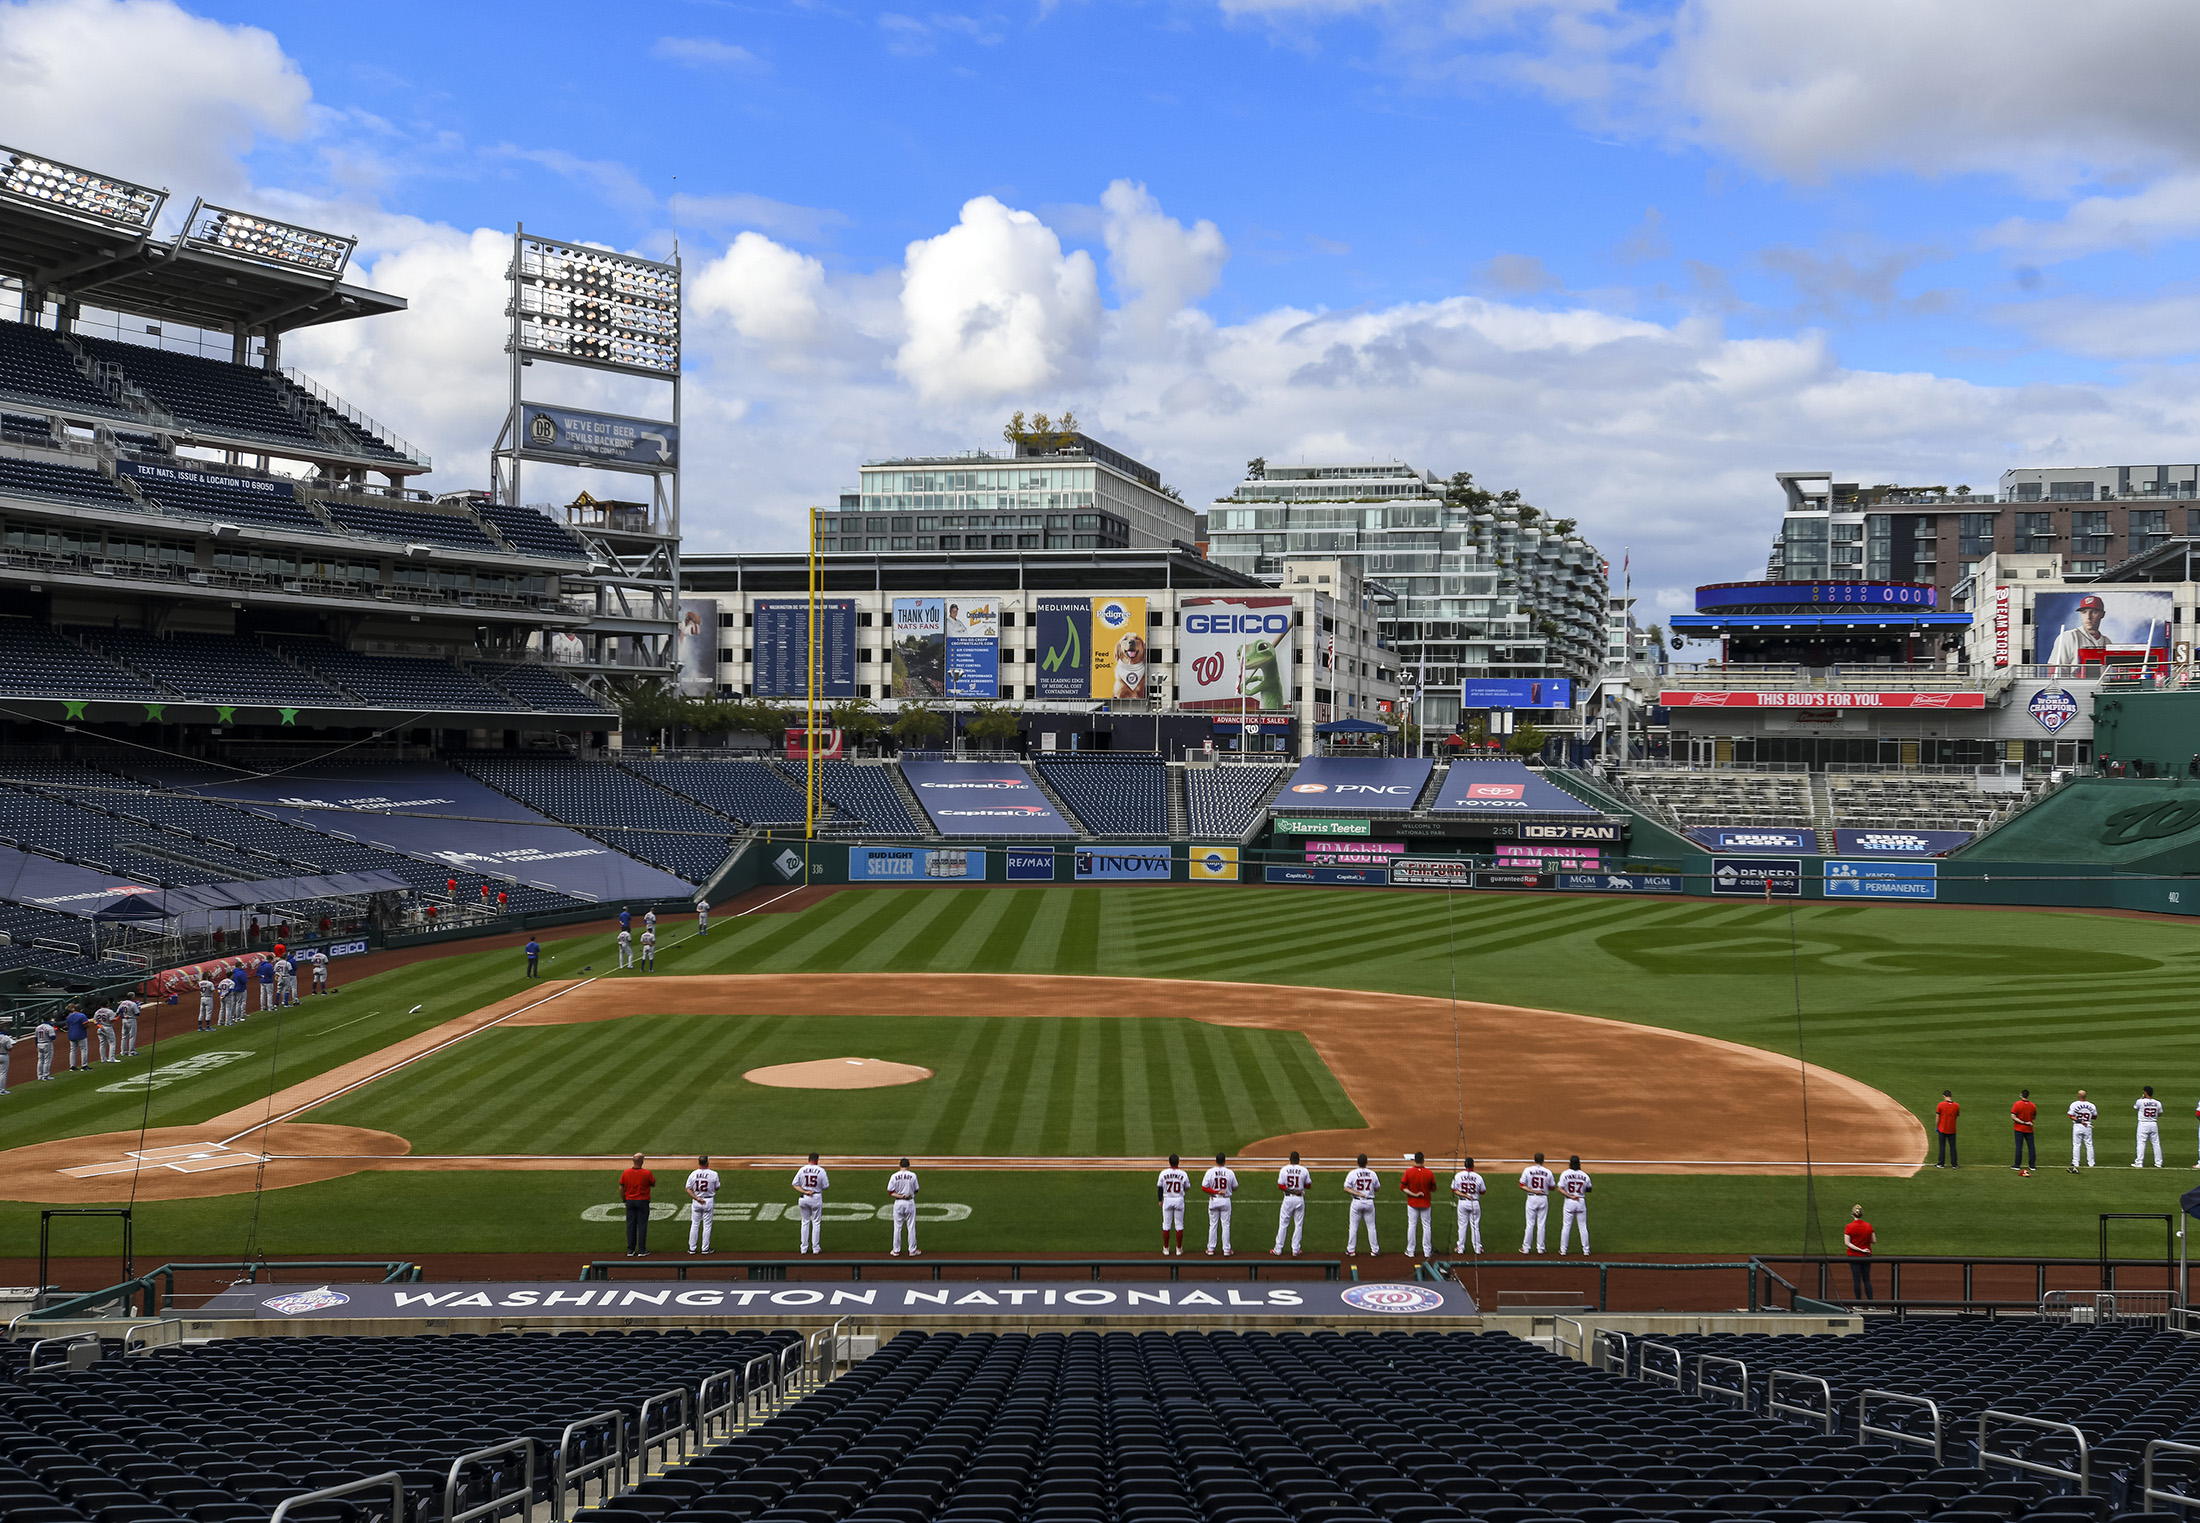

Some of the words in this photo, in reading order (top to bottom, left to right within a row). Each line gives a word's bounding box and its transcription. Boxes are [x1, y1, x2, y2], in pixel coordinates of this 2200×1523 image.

[564, 418, 592, 432] WE'VE
[593, 424, 610, 434] GOT
[613, 425, 637, 438] BEER.
[565, 431, 593, 444] DEVILS
[594, 435, 634, 450] BACKBONE
[573, 443, 599, 453] BREWING
[600, 446, 626, 456] COMPANY
[137, 465, 155, 475] TEXT
[156, 468, 176, 480] NATS,
[178, 471, 198, 482] ISSUE
[206, 475, 239, 487] LOCATION
[241, 480, 250, 488] TO
[251, 481, 274, 491] 69050
[1883, 588, 1893, 601] 0
[1900, 589, 1908, 602] 0
[1914, 590, 1921, 602] 0
[1037, 604, 1090, 612] MEDLIMINAL
[897, 609, 924, 623] THANK
[925, 606, 940, 623] YOU
[1096, 610, 1131, 619] Pedigree
[1996, 603, 2008, 628] TEAM
[1186, 614, 1288, 634] GEICO
[1771, 647, 1805, 656] ULTRA
[1826, 647, 1857, 656] LOFT
[1996, 630, 2008, 661] STORE
[1757, 693, 1785, 705] THIS
[1787, 693, 1825, 706] BUD'S
[1827, 693, 1852, 706] FOR
[1854, 693, 1883, 706] YOU.
[2036, 697, 2069, 705] WORLD
[2029, 704, 2077, 712] CHAMPIONS
[1335, 784, 1412, 795] PNC
[1292, 822, 1328, 833] Harris
[1331, 822, 1367, 834] Teeter
[1493, 827, 1514, 835] 2:56
[1572, 827, 1614, 839] FAN
[868, 859, 913, 875] SELTZER
[1009, 858, 1051, 868] RE/MAX
[1099, 855, 1169, 872] INOVA
[1547, 861, 1559, 872] 377
[812, 864, 823, 875] 336
[1569, 875, 1596, 884] MGM
[1643, 877, 1671, 886] MGM
[1865, 883, 1926, 893] PERMANENTE
[2168, 891, 2179, 903] 402
[330, 941, 365, 957] GEICO
[2143, 1107, 2157, 1118] 62
[695, 1180, 709, 1192] 12
[804, 1175, 818, 1187] 15
[1166, 1181, 1181, 1193] 70
[1214, 1177, 1227, 1190] 18
[1286, 1176, 1299, 1188] 51
[1356, 1179, 1372, 1191] 57
[1531, 1177, 1544, 1189] 61
[1567, 1181, 1584, 1194] 67
[580, 1202, 972, 1221] GEICO
[393, 1289, 877, 1308] WASHINGTON
[902, 1288, 1305, 1307] NATIONALS
